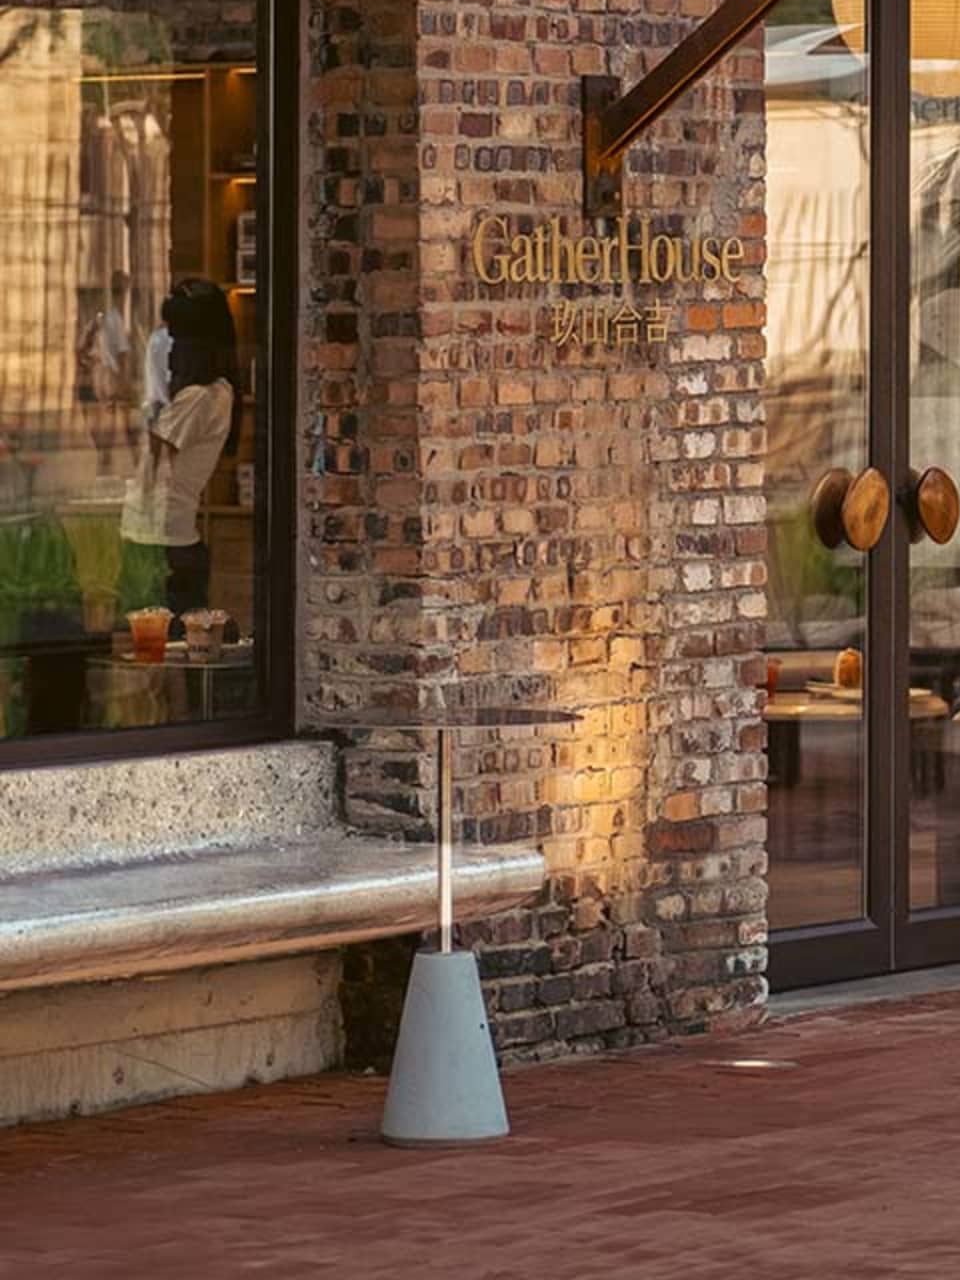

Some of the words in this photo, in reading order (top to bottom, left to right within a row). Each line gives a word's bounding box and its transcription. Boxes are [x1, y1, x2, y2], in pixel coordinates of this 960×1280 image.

[472, 216, 745, 284] GatherHouse
[551, 298, 673, 348] 玖山合吉
